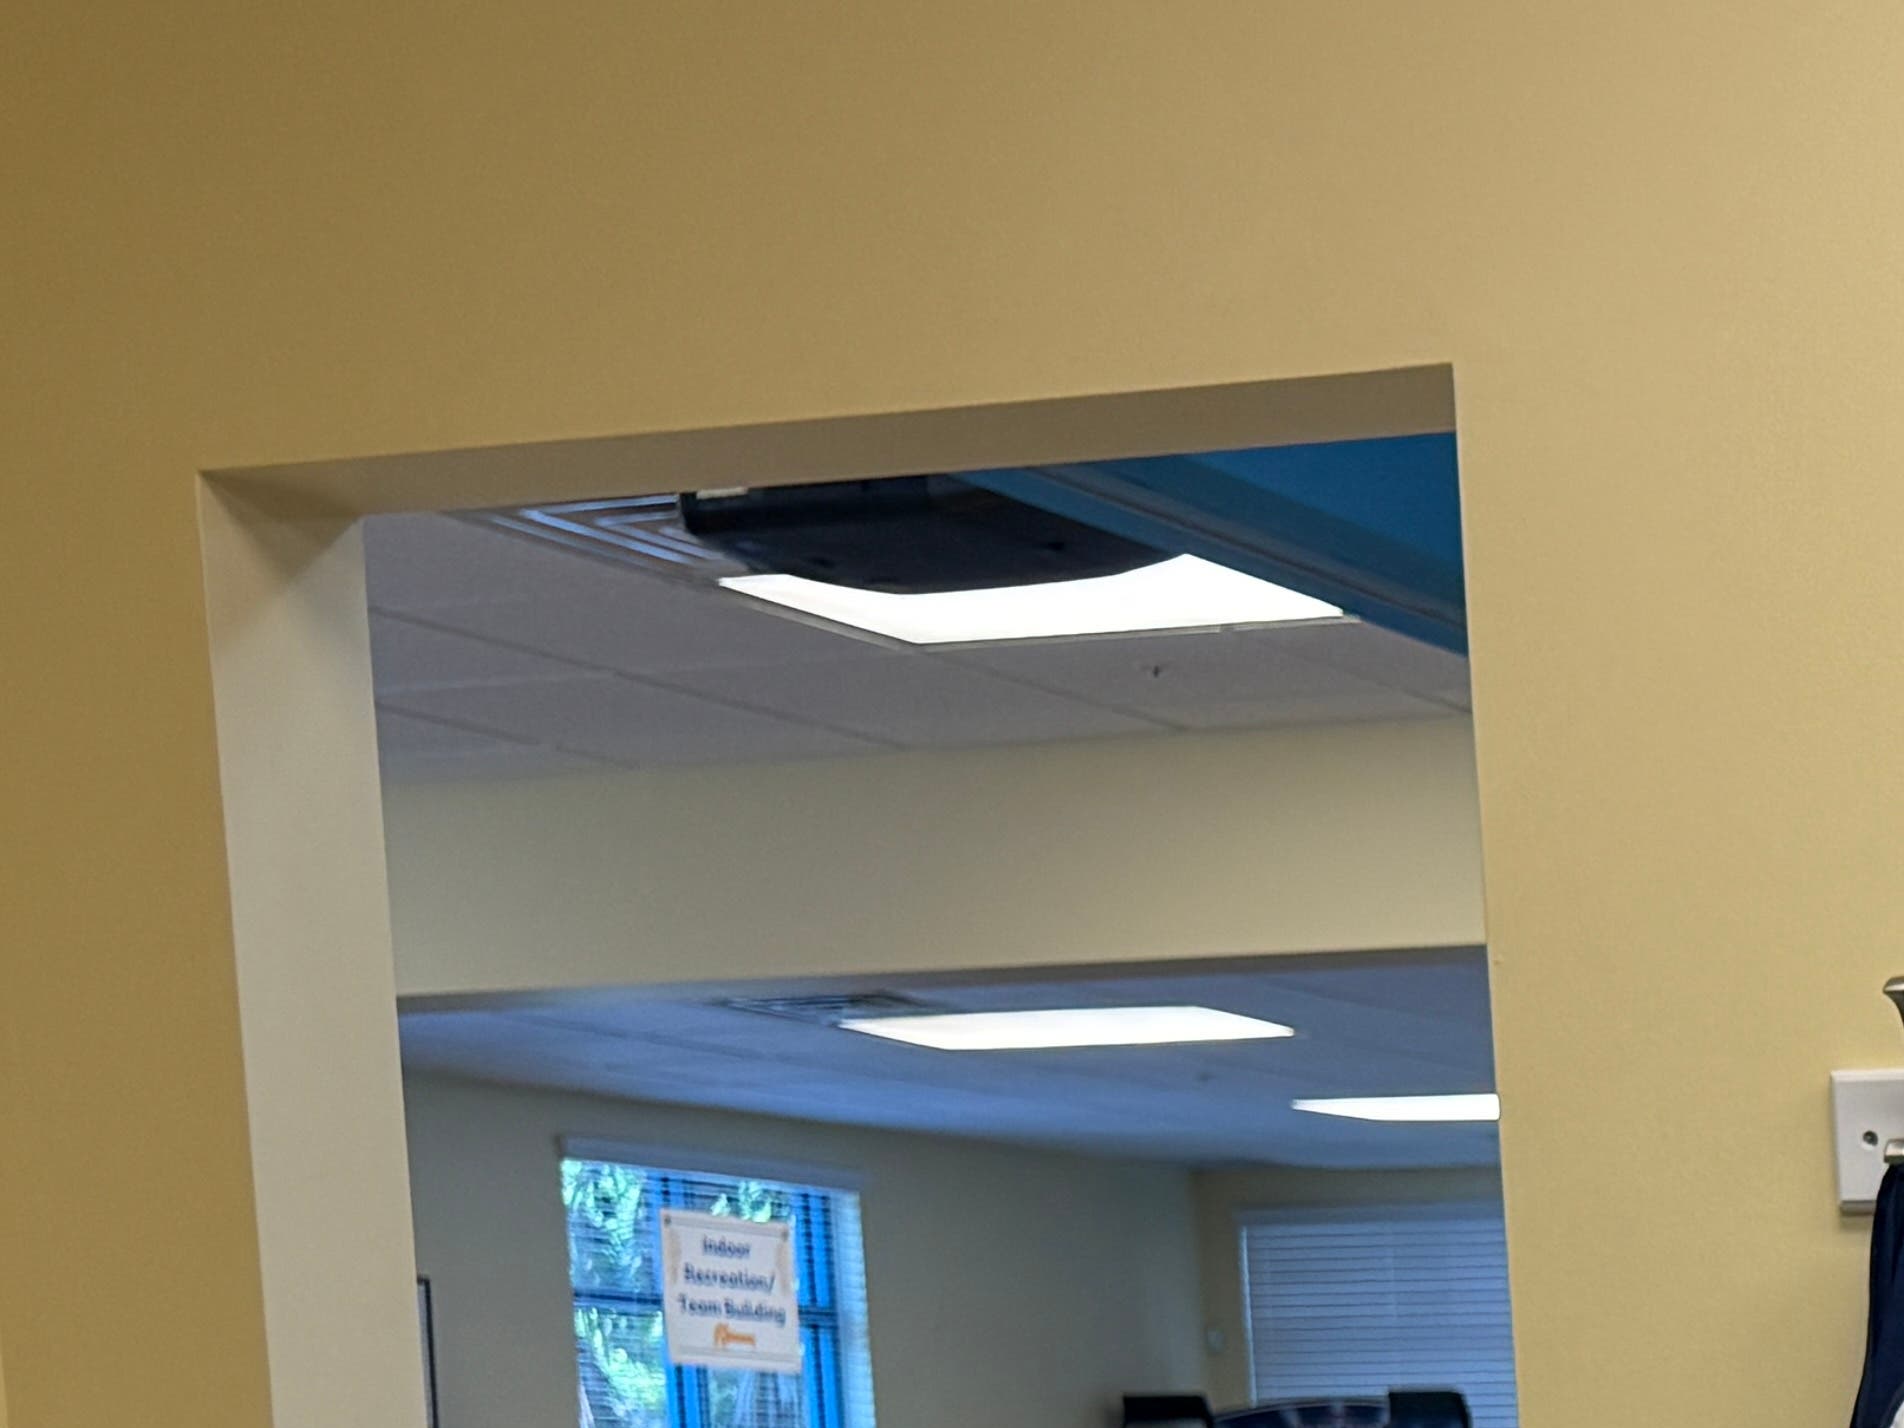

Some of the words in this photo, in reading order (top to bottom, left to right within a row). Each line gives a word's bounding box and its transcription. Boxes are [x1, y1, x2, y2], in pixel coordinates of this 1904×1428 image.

[703, 1236, 751, 1257] Indoor
[679, 1295, 721, 1316] Team
[724, 1299, 786, 1326] Building
